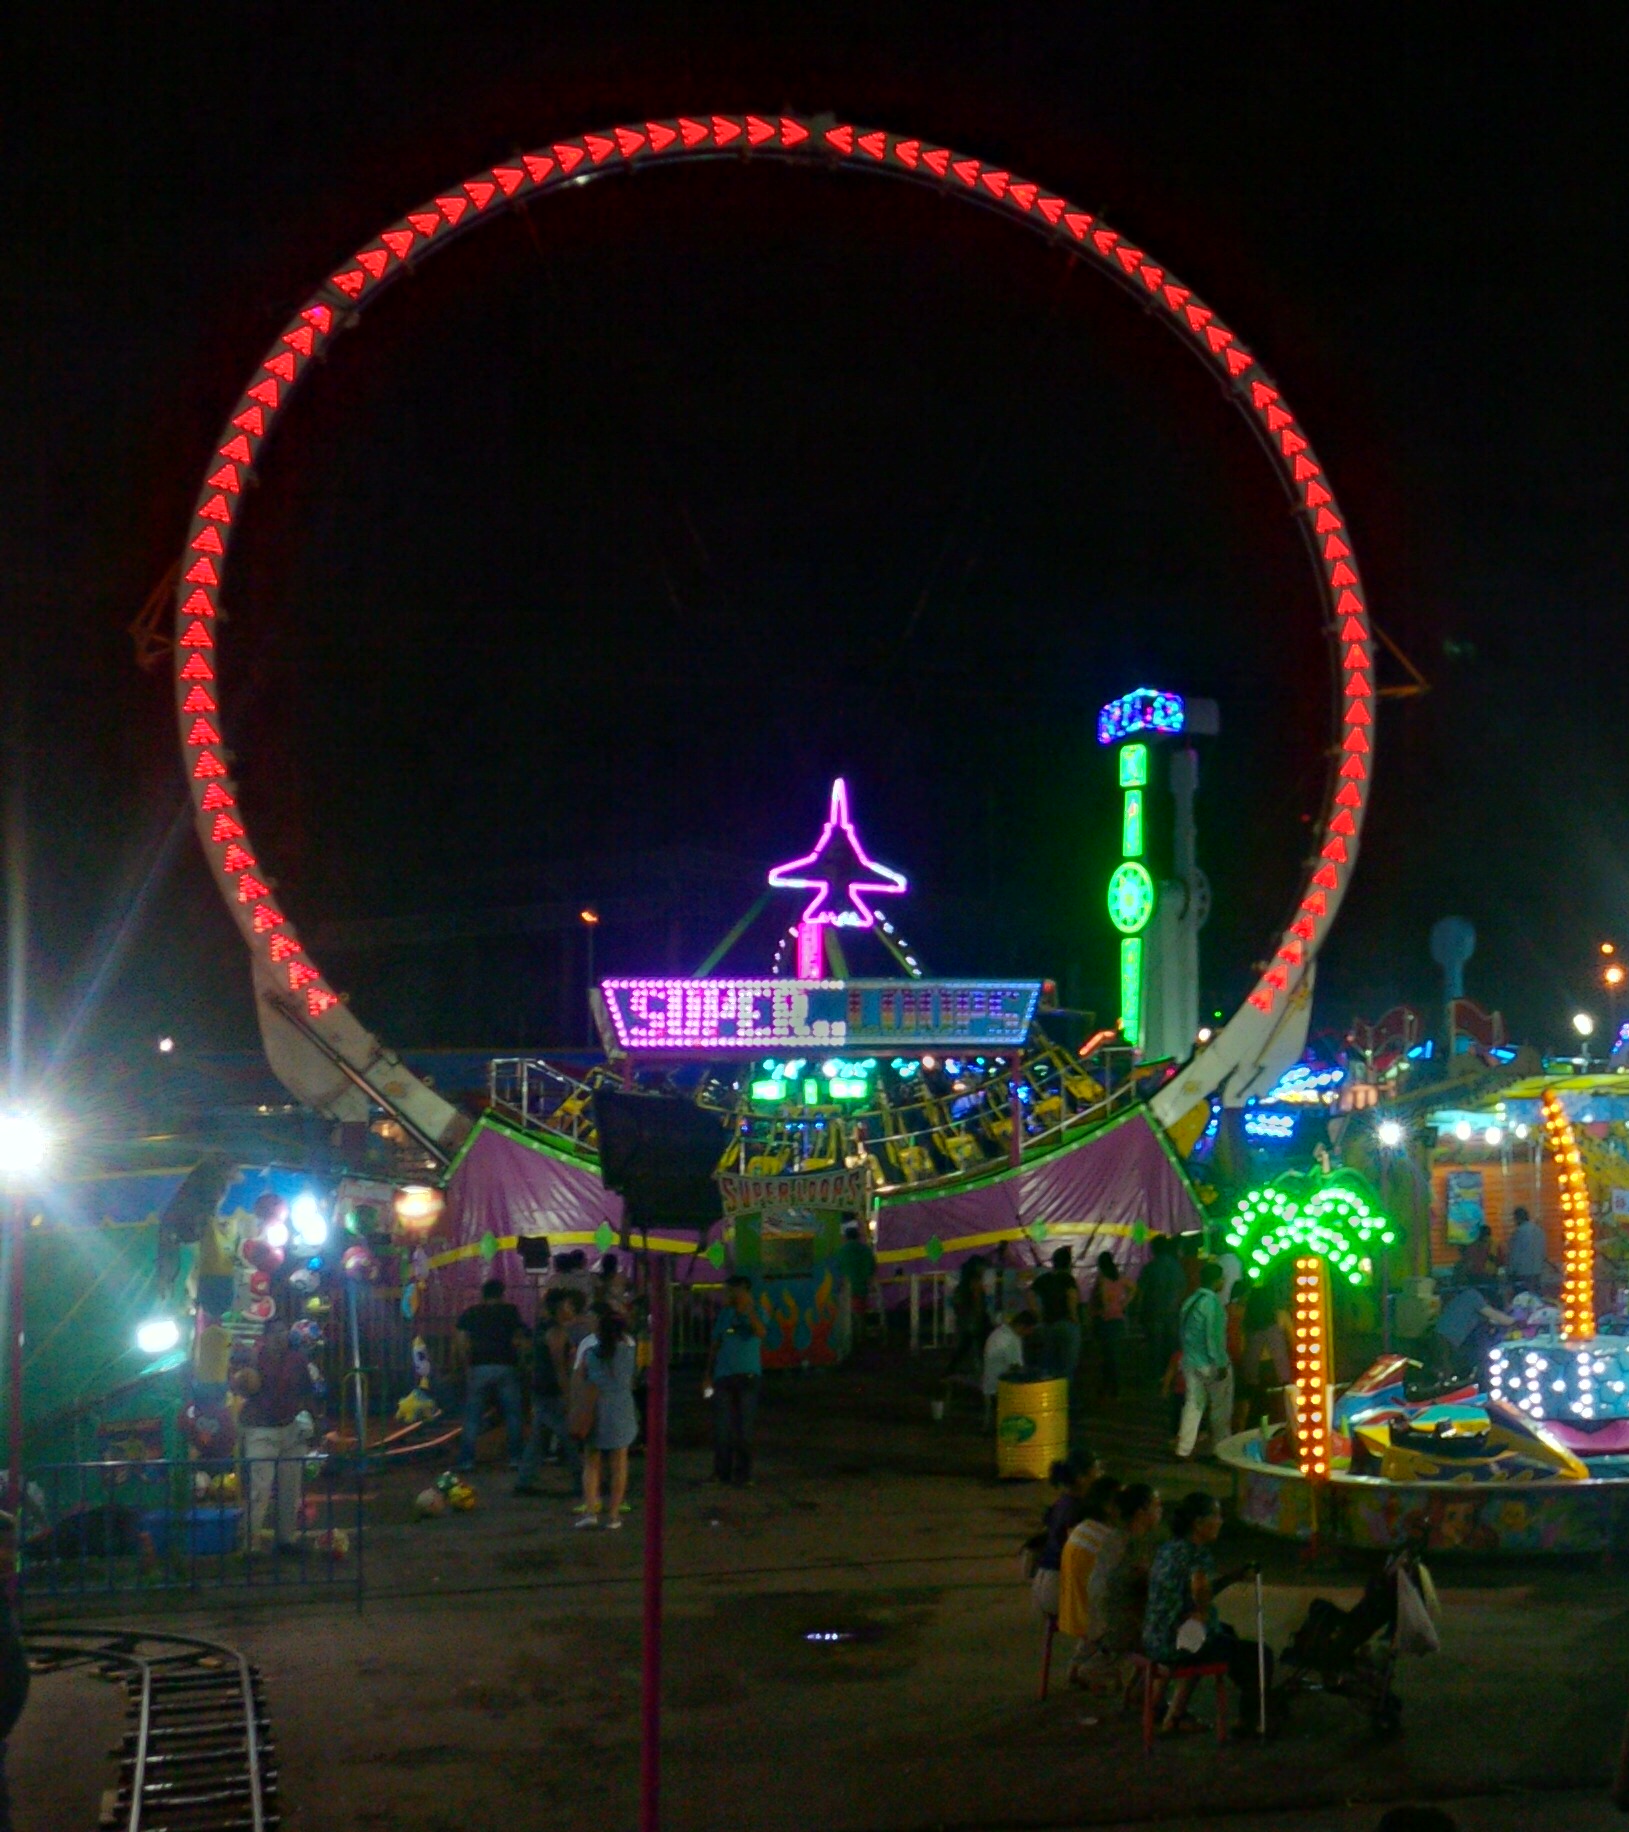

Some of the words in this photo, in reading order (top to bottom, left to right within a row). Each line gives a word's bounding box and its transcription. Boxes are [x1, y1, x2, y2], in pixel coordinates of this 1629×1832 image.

[629, 987, 812, 1037] SUPER
[847, 988, 1020, 1036] LOOPS
[721, 1176, 790, 1212] SUPER
[796, 1171, 860, 1206] LOOPS
